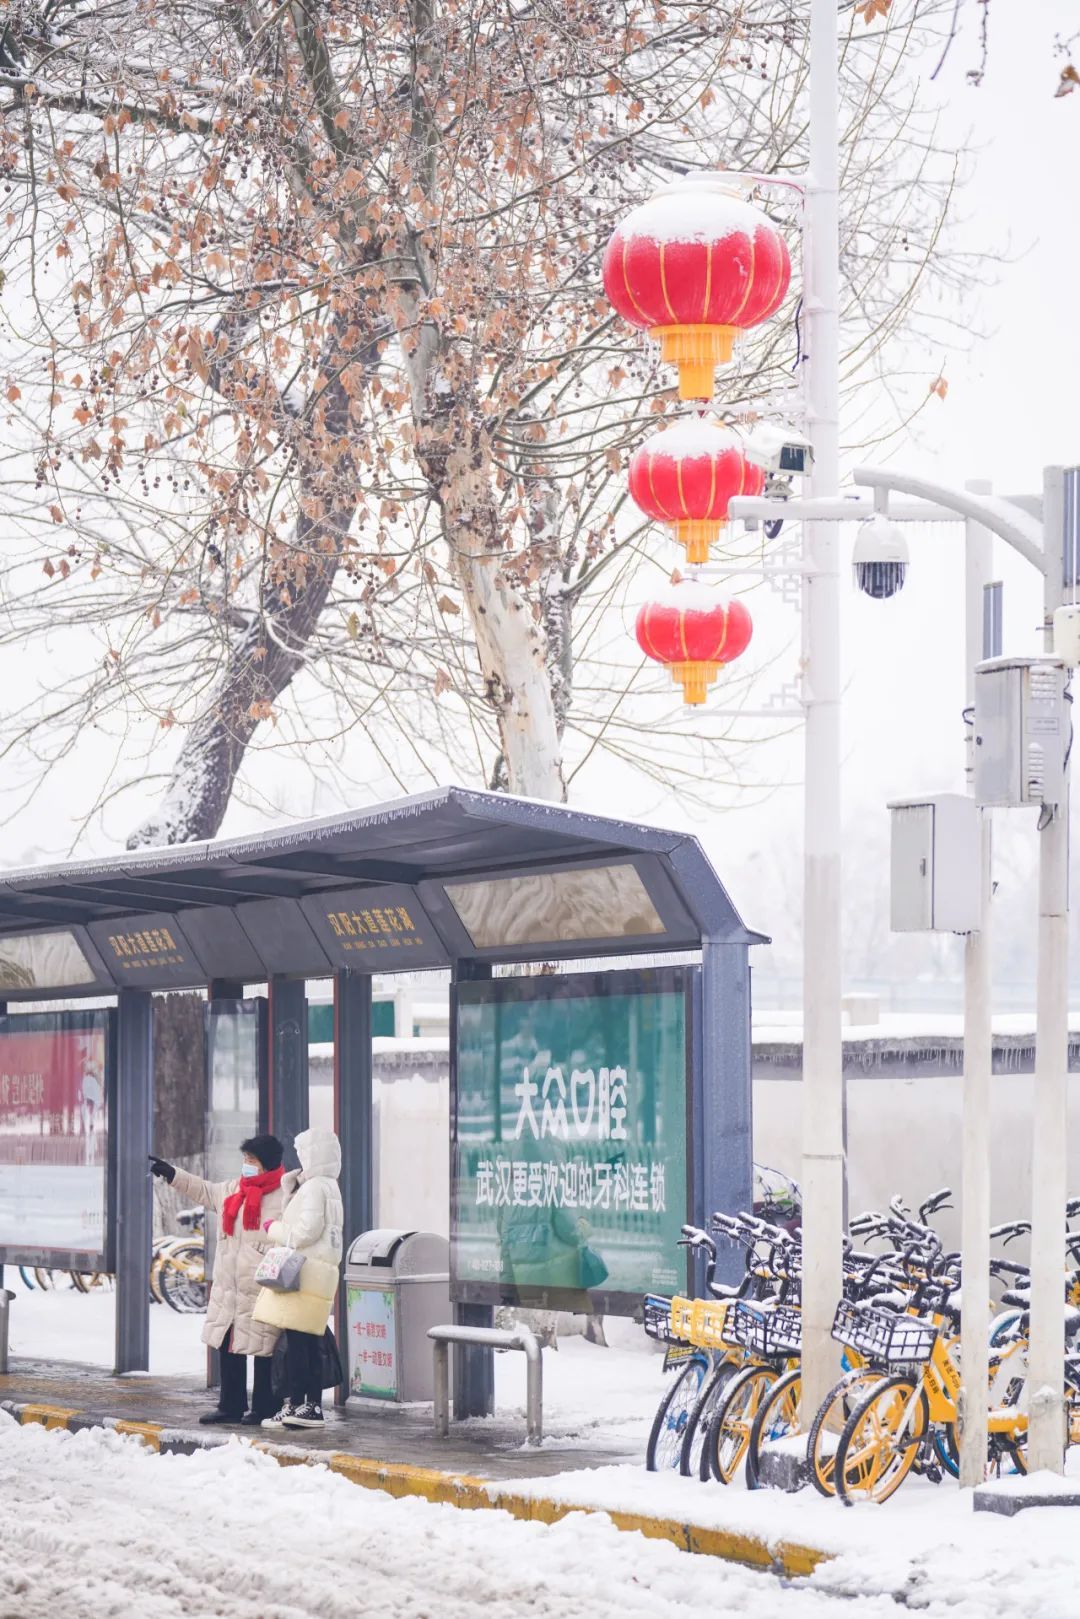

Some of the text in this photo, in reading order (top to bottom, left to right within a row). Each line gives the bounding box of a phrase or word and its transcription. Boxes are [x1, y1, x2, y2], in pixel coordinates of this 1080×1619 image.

[514, 1065, 628, 1140] 大众口腔
[475, 1160, 666, 1212] 武汉更受欢迎的牙科连锁
